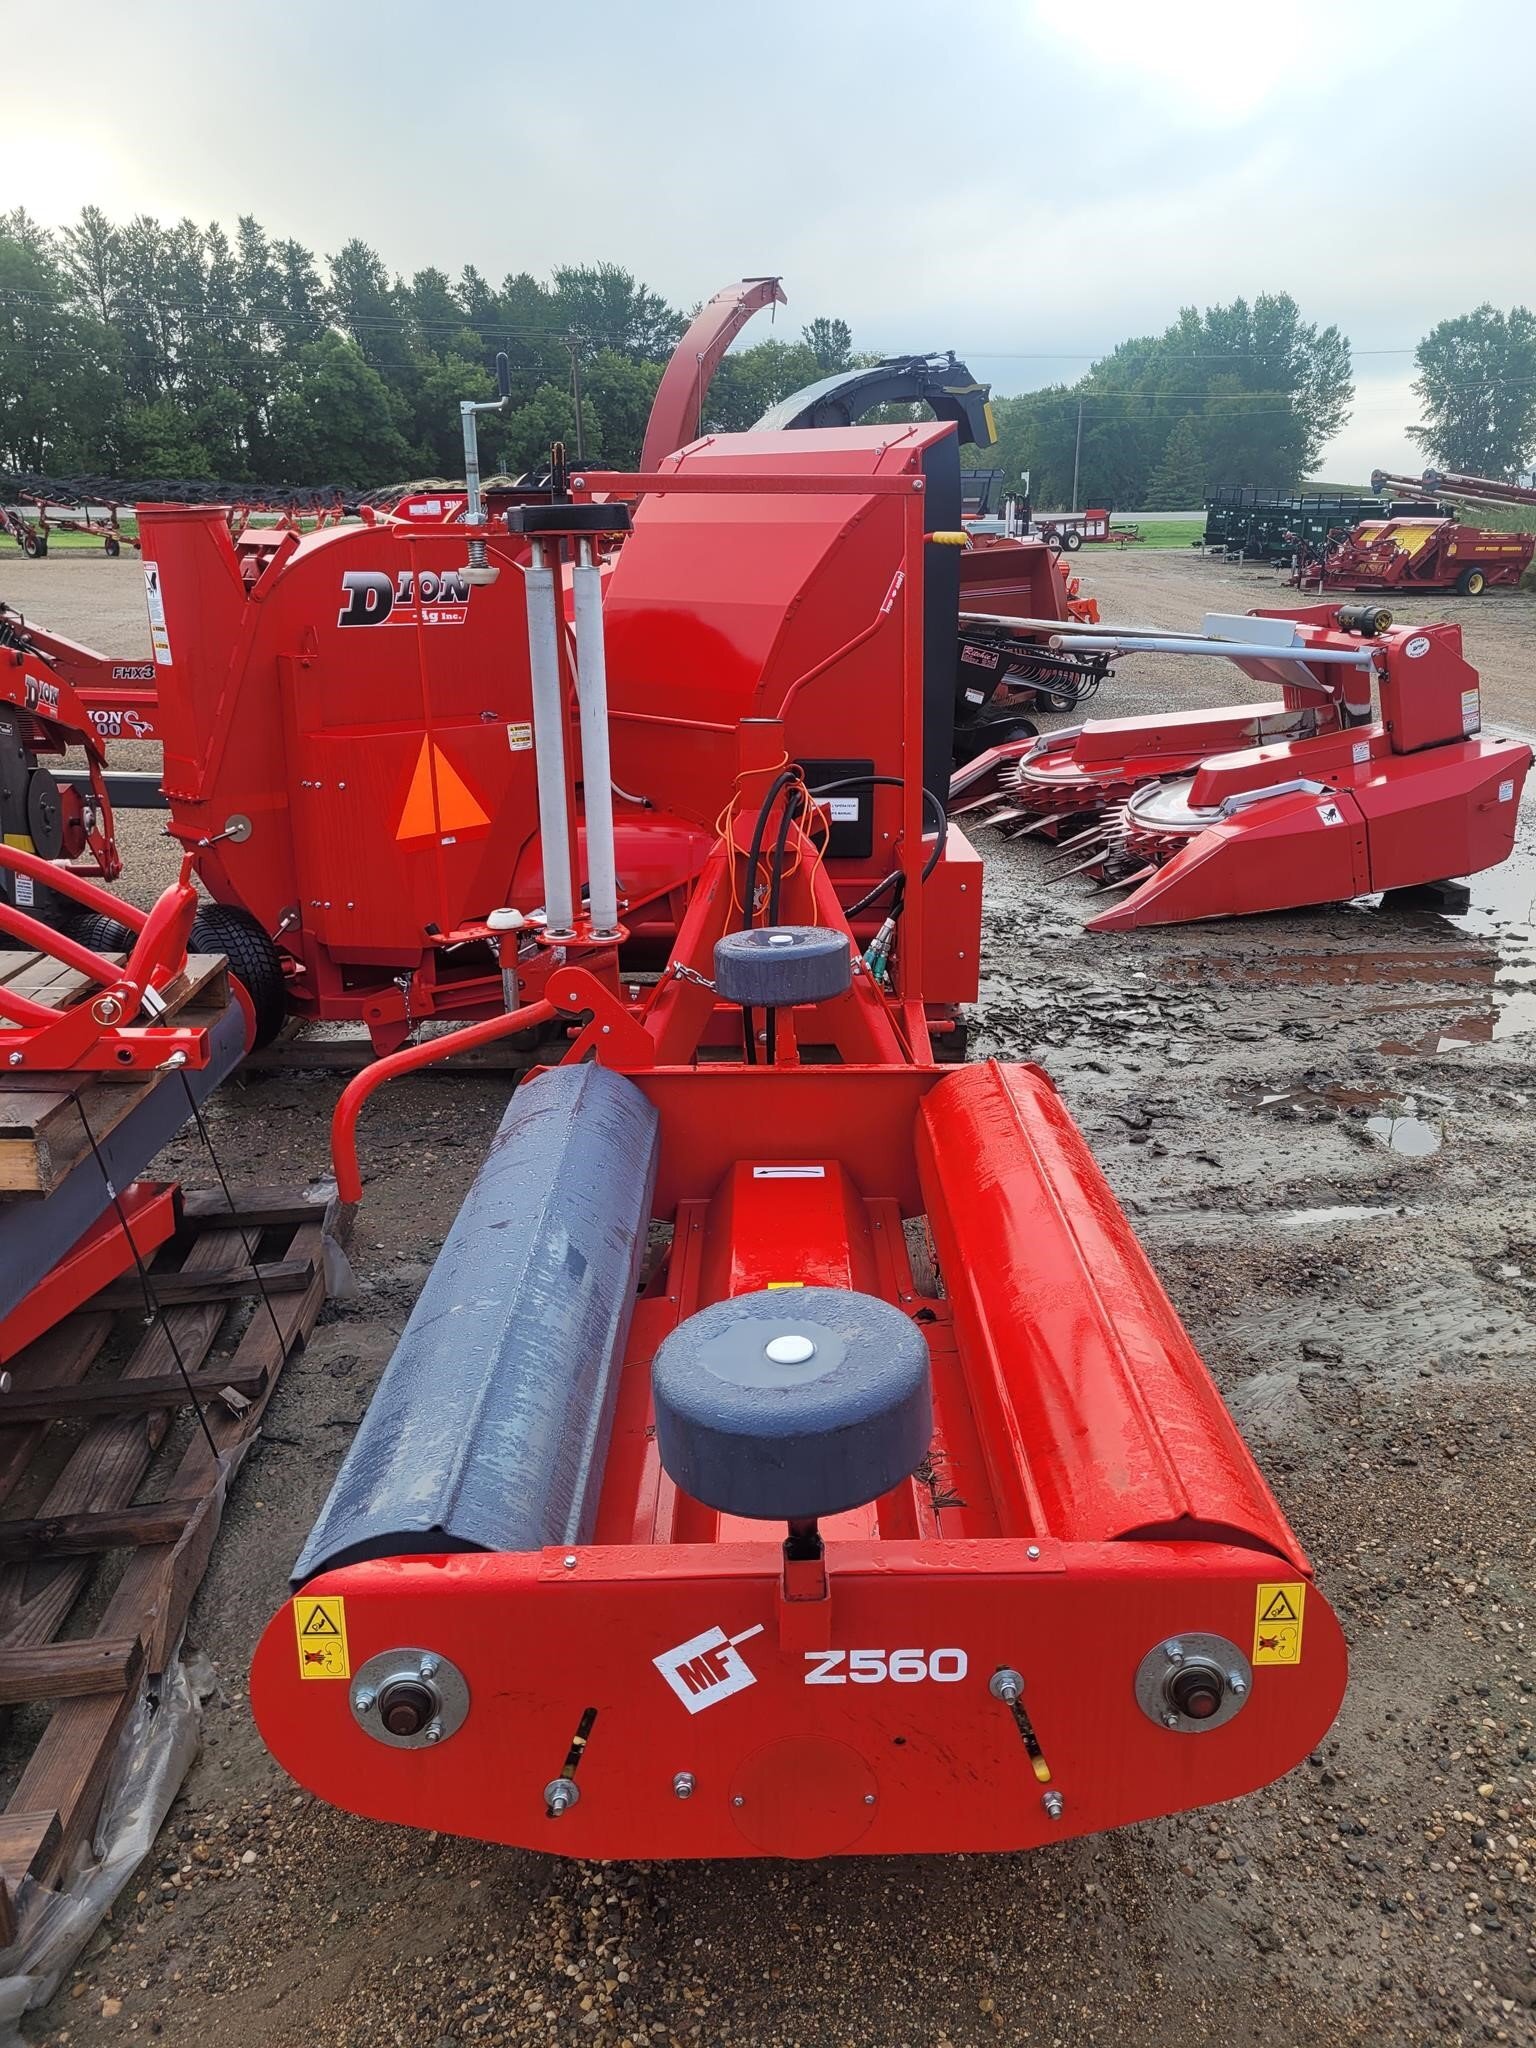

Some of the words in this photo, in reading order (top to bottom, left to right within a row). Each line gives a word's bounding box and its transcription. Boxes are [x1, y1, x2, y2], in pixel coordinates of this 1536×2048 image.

[337, 571, 471, 628] DION
[441, 612, 462, 620] Inc.
[675, 1643, 737, 1696] MF
[804, 1648, 968, 1685] Z560
